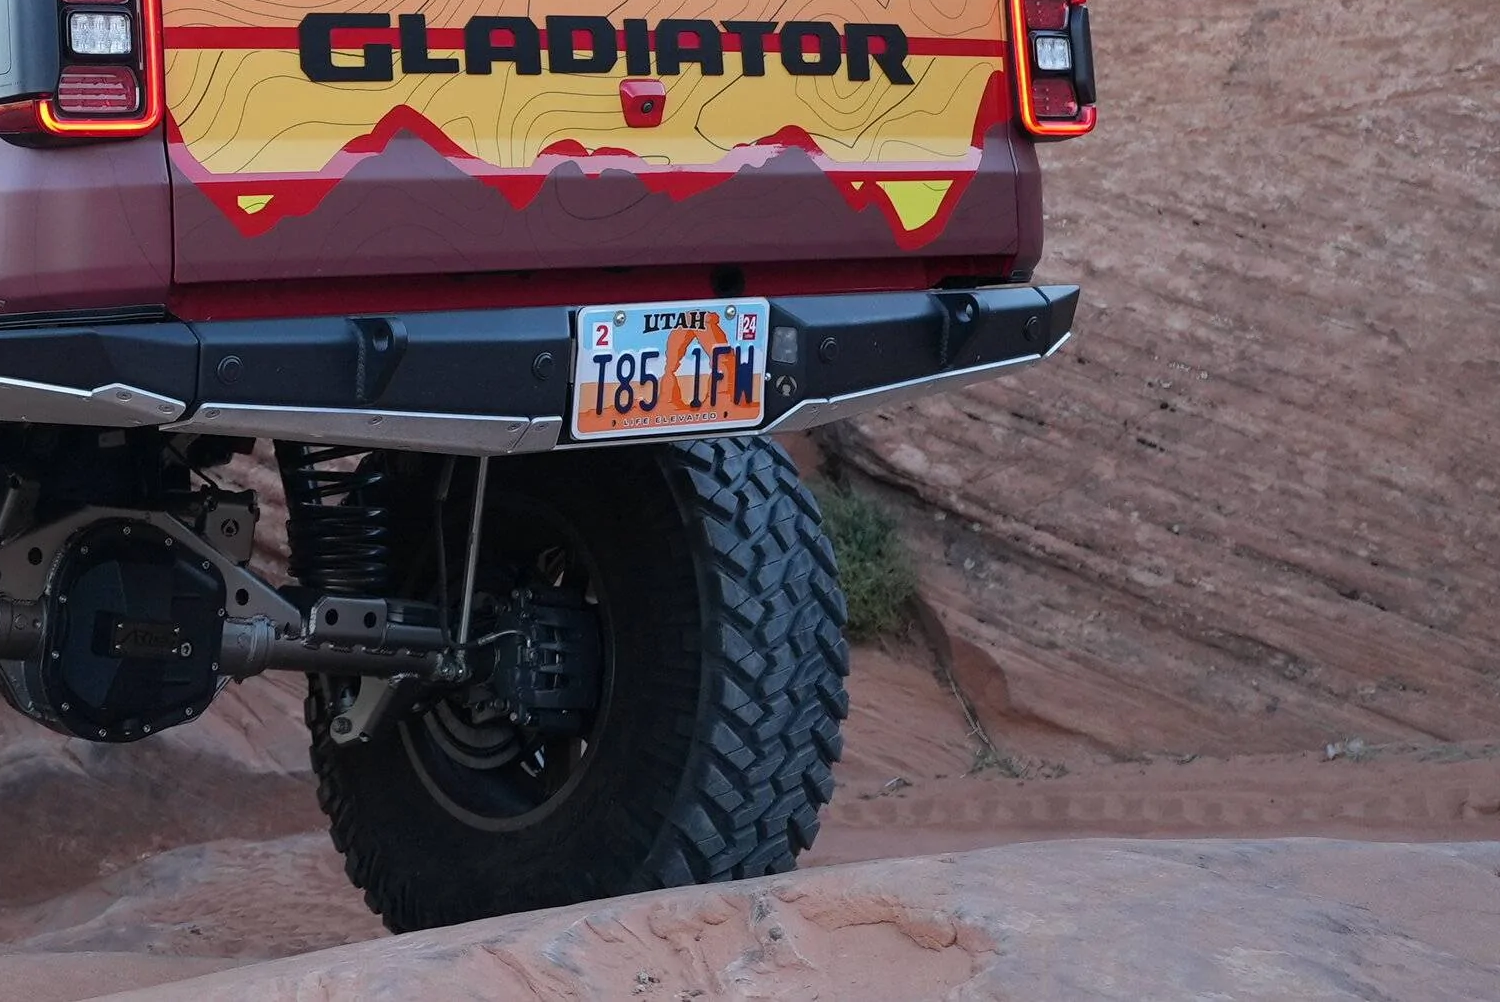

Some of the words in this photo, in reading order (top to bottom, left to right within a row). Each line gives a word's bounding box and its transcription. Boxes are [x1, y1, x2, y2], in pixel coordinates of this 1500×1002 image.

[298, 11, 915, 86] GLADIATOR
[642, 311, 706, 334] UTAH
[743, 316, 756, 333] 24
[595, 325, 609, 346] 2
[593, 351, 660, 415] T85
[690, 345, 755, 408] 1FW
[622, 417, 650, 427] LIFE
[655, 412, 718, 425] ELEVATED
